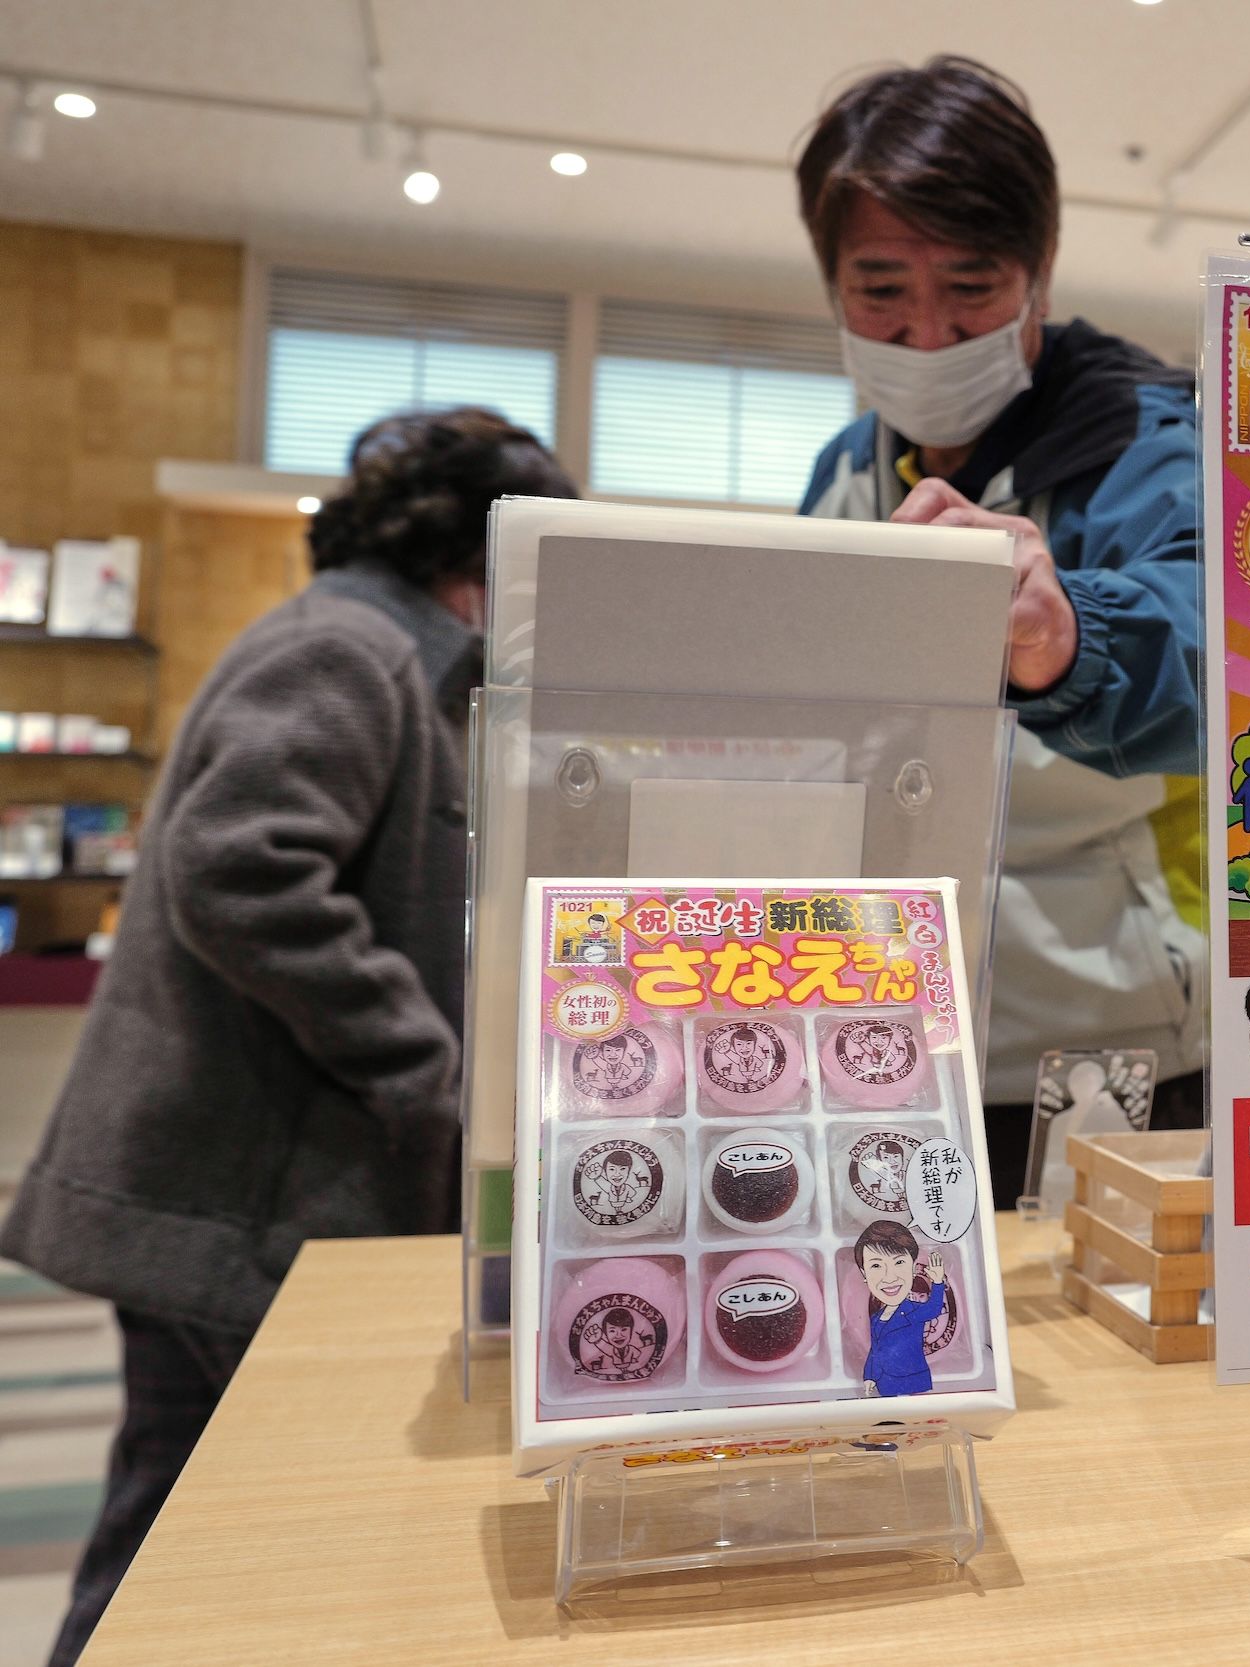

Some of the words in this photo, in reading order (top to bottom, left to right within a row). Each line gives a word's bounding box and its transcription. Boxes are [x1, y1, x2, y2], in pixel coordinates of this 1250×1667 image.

[1239, 384, 1249, 442] NIPPON
[560, 902, 593, 912] 1021
[633, 940, 917, 1007] さなえちゃん
[563, 995, 617, 1009] 女性初の
[568, 1011, 610, 1026] 総理
[727, 1152, 783, 1162] こしあん
[941, 1148, 962, 1185] 私が
[727, 1290, 788, 1305] こしあん
